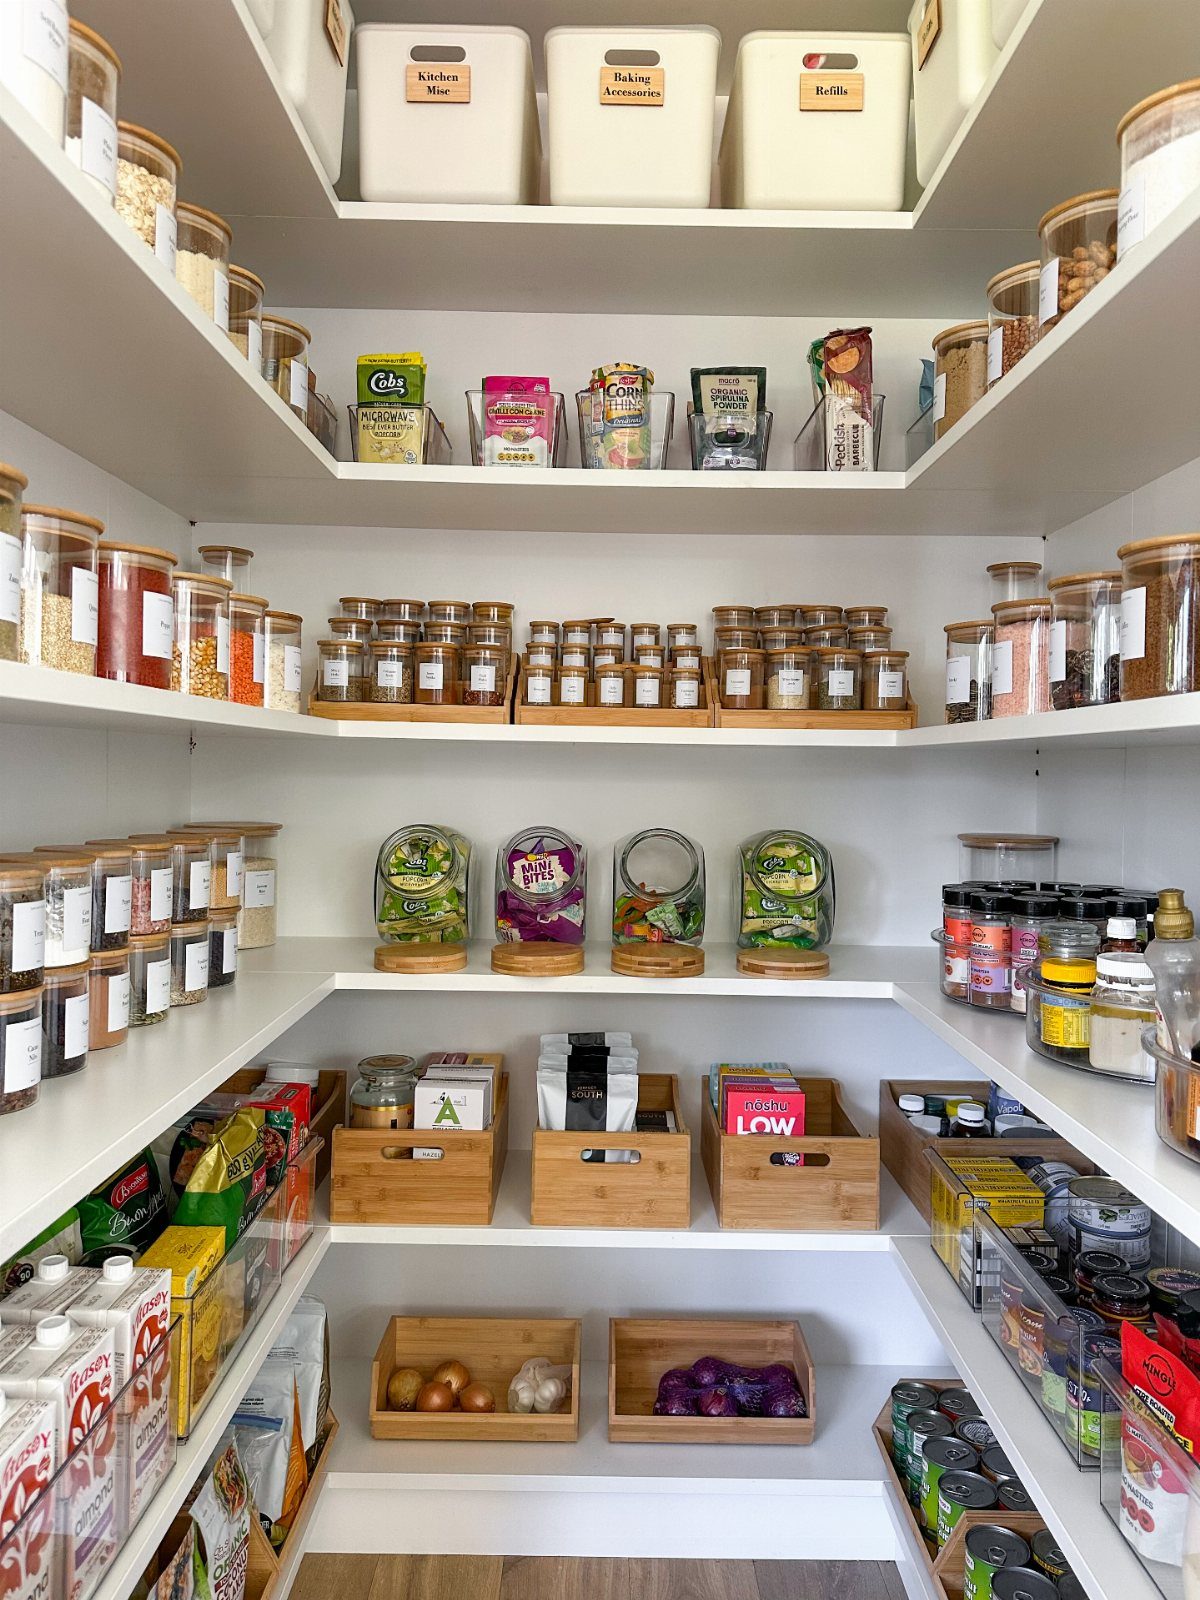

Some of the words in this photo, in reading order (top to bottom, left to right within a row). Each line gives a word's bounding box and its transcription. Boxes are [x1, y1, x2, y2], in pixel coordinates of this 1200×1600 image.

[417, 71, 459, 82] Kitchen
[614, 72, 651, 85] Baking
[426, 86, 450, 96] Misc
[603, 87, 662, 98] Accessories
[815, 86, 848, 96] Refills
[371, 372, 405, 395] Cobs
[606, 383, 643, 399] CORN
[710, 387, 748, 395] ORGANIC
[608, 399, 645, 412] THINS
[713, 401, 748, 409] POWDER
[361, 411, 415, 422] MICROWAVE
[834, 422, 846, 467] Peckish
[852, 423, 860, 466] BARBECUE
[522, 869, 555, 886] BITES
[571, 1091, 603, 1100] SOUTH
[736, 1115, 796, 1136] LOW
[20, 1270, 31, 1282] 90
[1142, 1357, 1177, 1392] MINGLE
[1149, 1398, 1174, 1424] ROASTED
[135, 1394, 169, 1450] almond
[74, 1469, 114, 1537] almond
[1127, 1482, 1155, 1511] NASTIES
